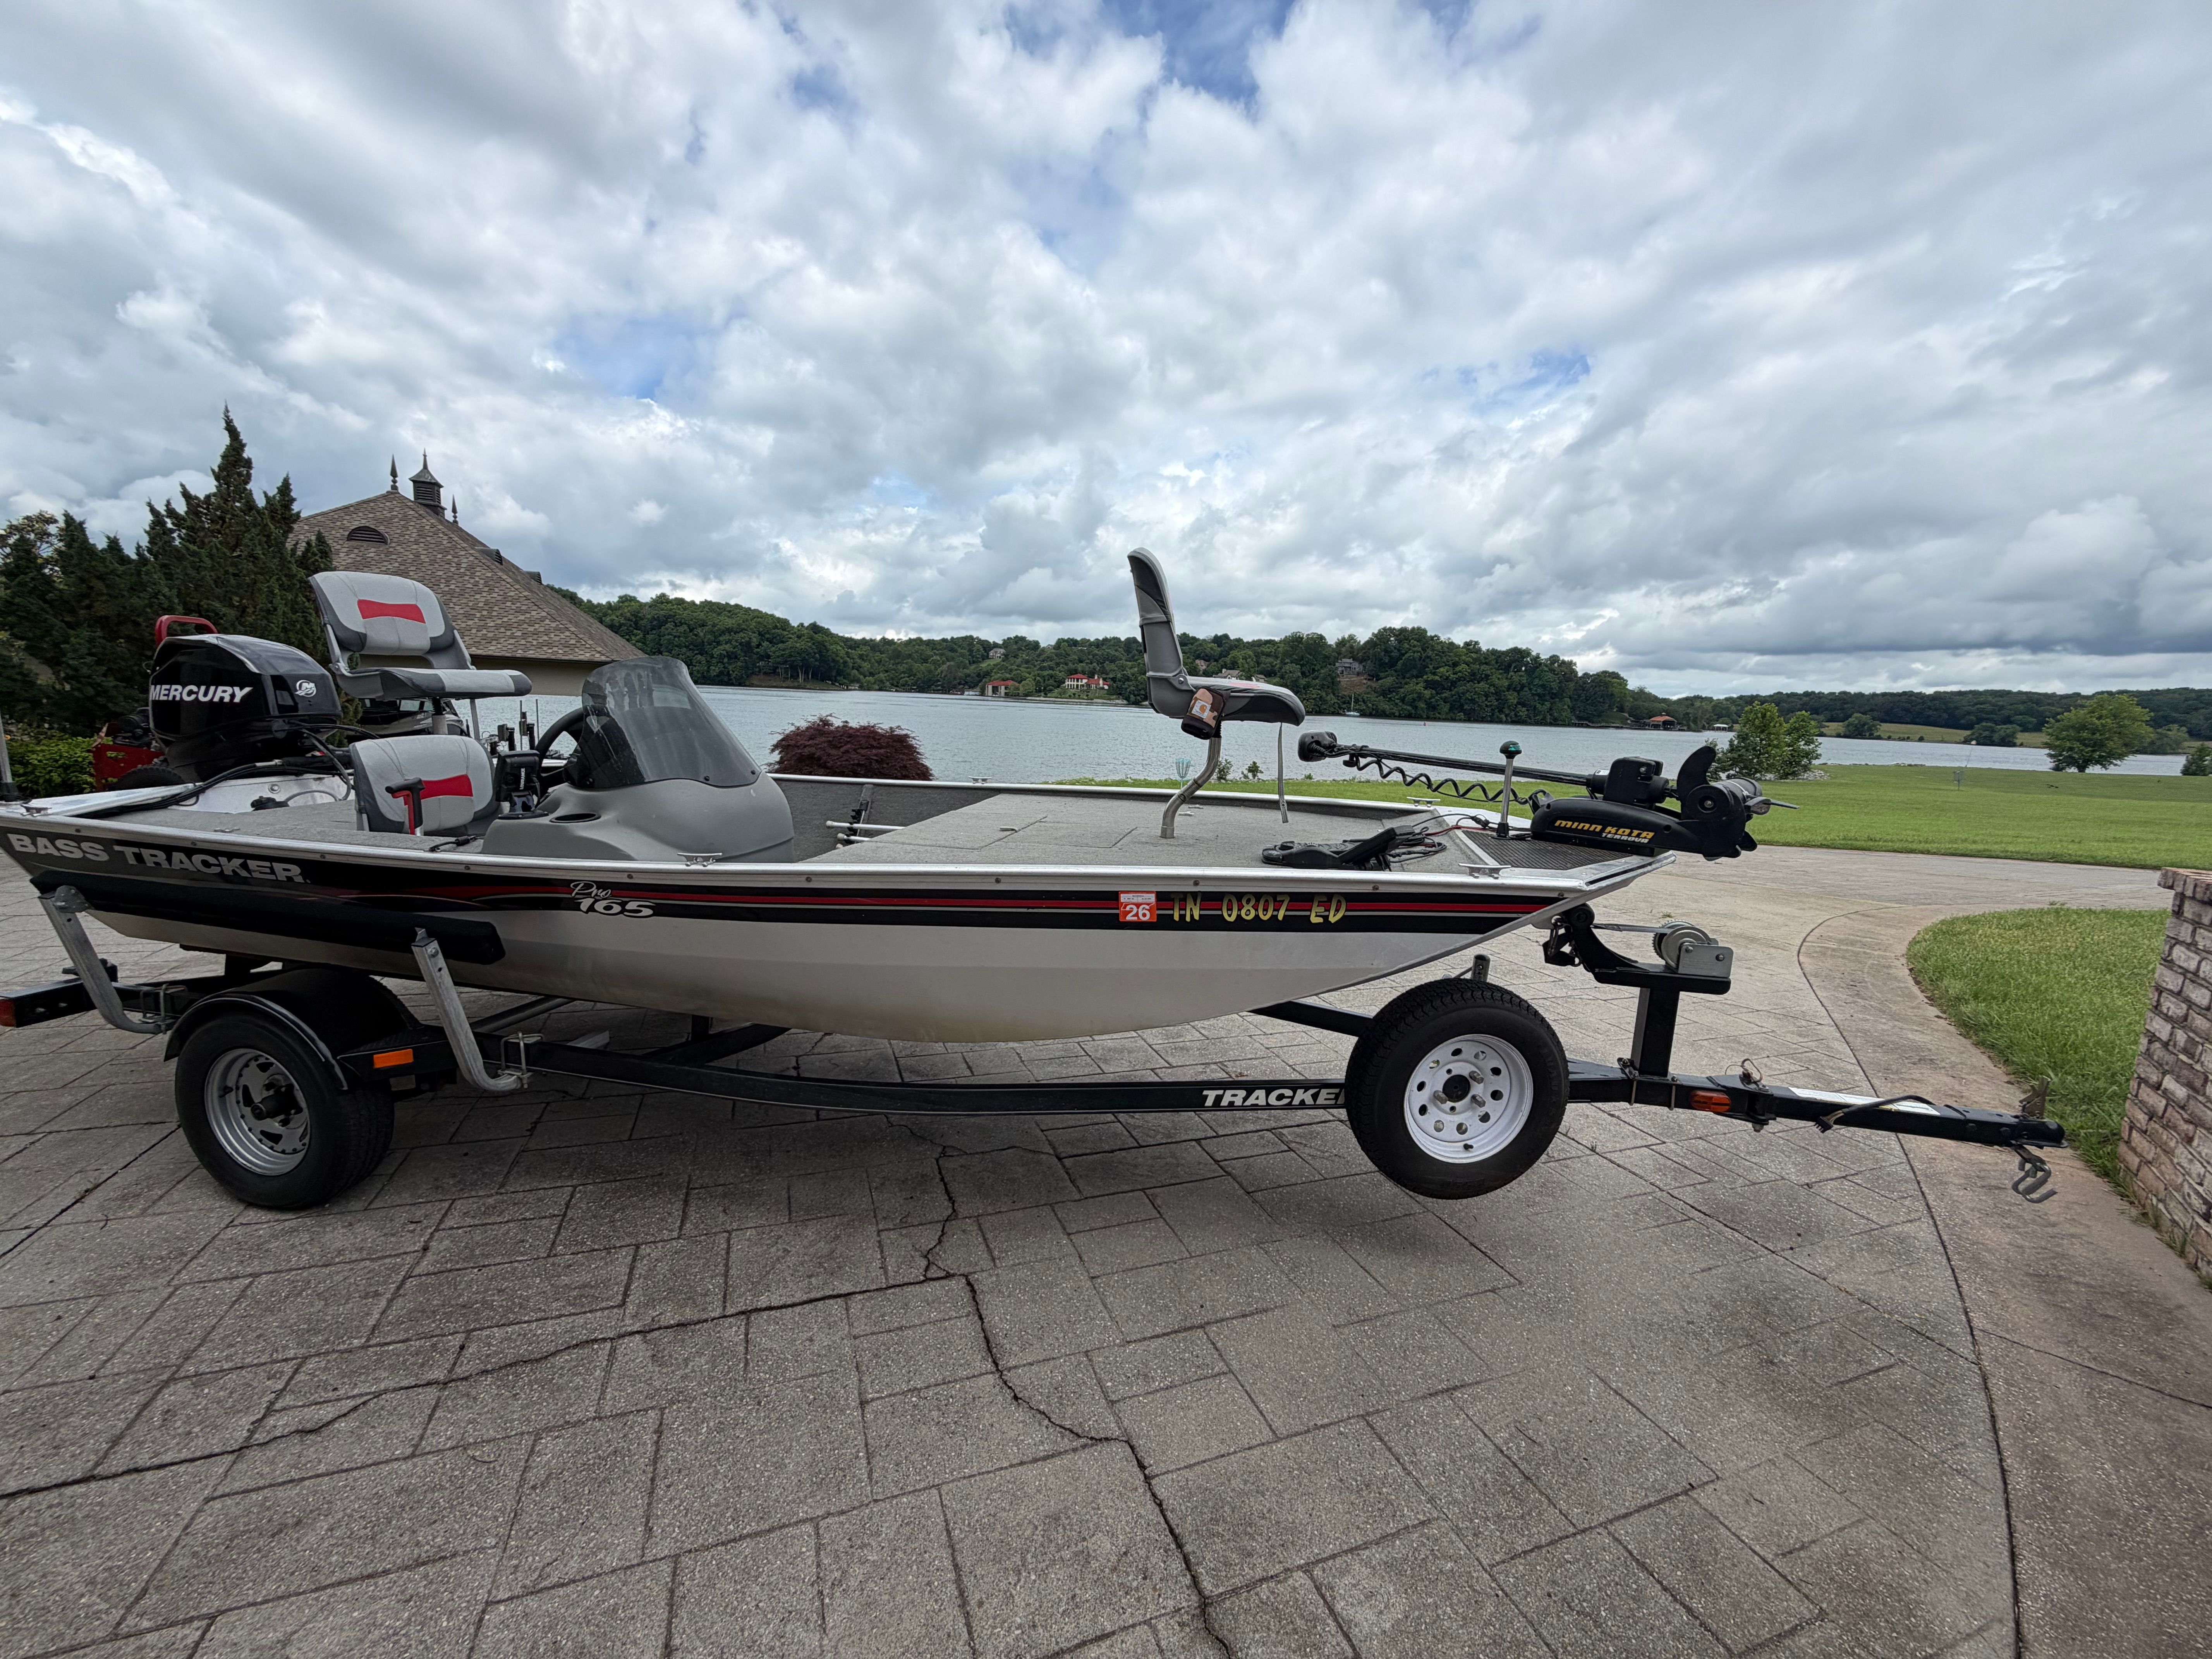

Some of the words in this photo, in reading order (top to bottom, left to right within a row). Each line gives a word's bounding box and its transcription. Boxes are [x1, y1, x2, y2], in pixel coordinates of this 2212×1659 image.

[149, 685, 254, 703] MERCURY
[1602, 833, 1649, 843] TERROVA
[1604, 826, 1655, 839] KOTA
[7, 833, 110, 862] BASS
[113, 845, 305, 883] TRACKER
[570, 881, 612, 898] Pro
[574, 897, 656, 917] 165
[1126, 904, 1150, 921] 26
[1171, 891, 1201, 922] TN
[1222, 894, 1290, 922] 0807
[1310, 894, 1346, 923] ED
[1202, 1089, 1345, 1106] TRACKE
